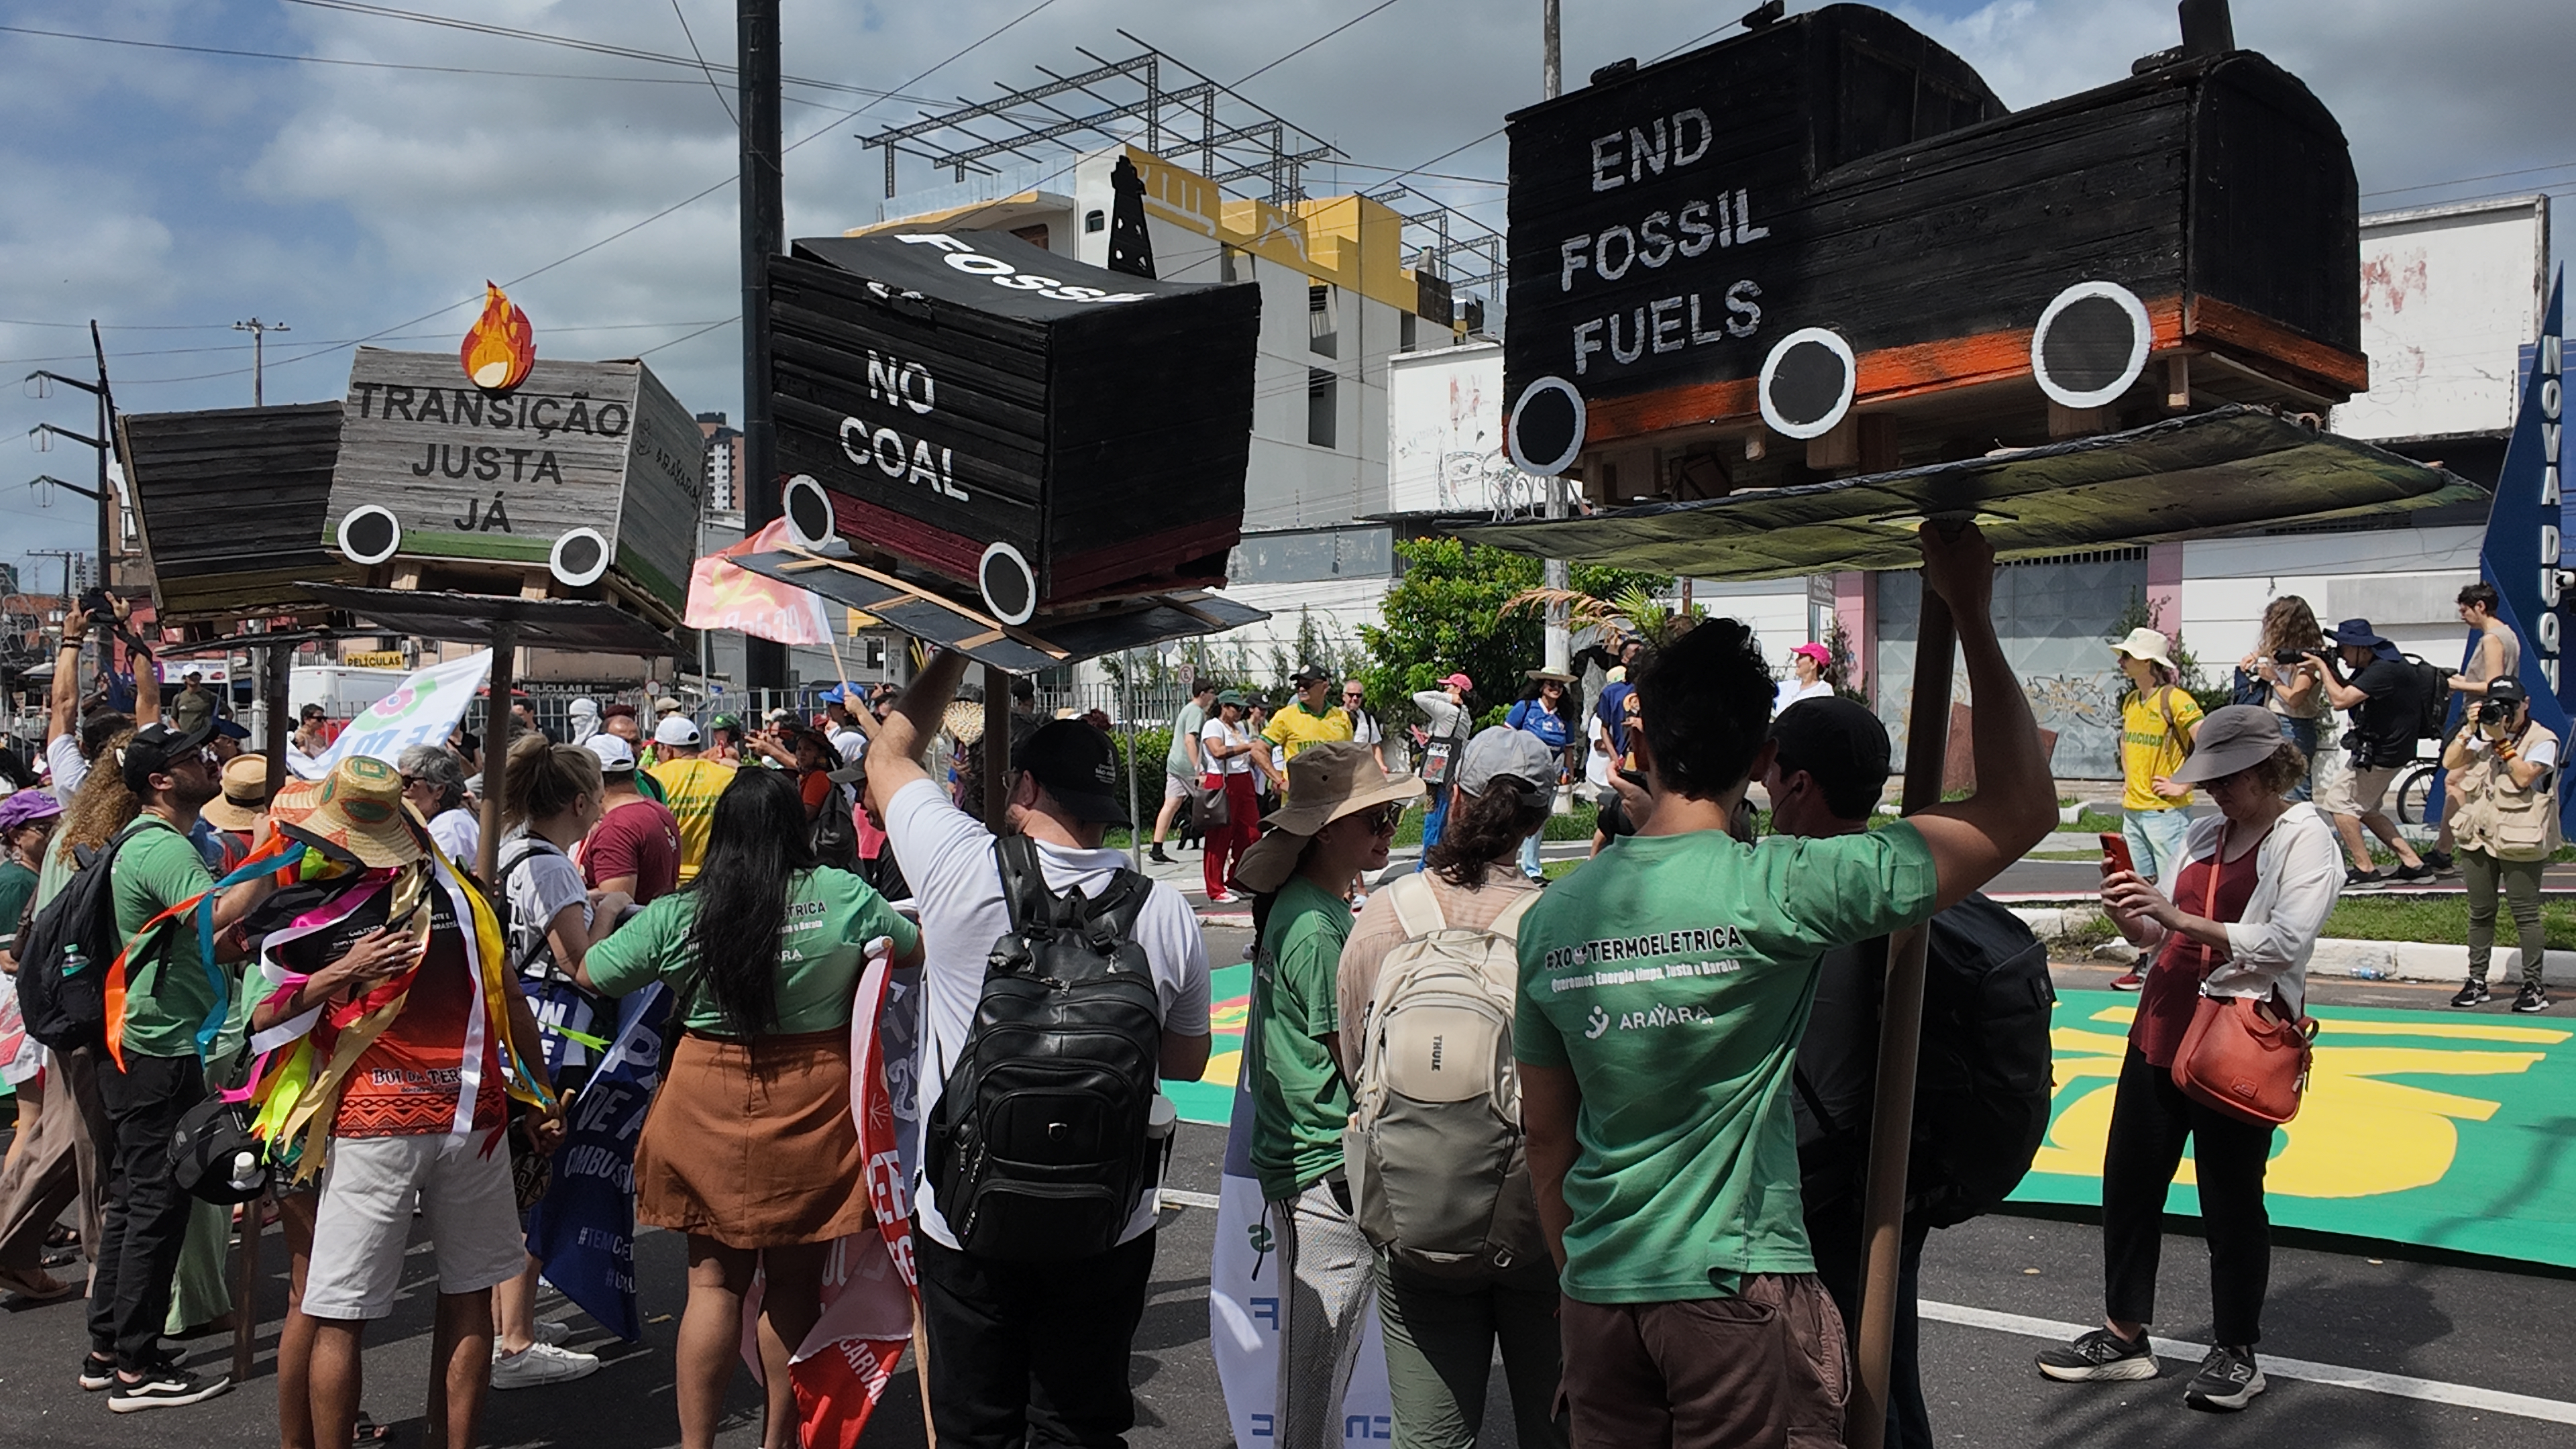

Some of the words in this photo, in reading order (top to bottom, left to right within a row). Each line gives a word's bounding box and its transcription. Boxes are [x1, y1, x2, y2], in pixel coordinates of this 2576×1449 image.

[1591, 107, 1713, 193] END
[1561, 188, 1770, 292] FOSSIL
[1572, 279, 1763, 376] FUELS
[867, 350, 935, 414] NO
[353, 382, 631, 439] TRANSIÇÃO
[2540, 335, 2562, 506] NOVA
[412, 443, 563, 485] JUSTA
[839, 416, 970, 502] COAL
[453, 490, 512, 534] JÁ
[347, 655, 400, 667] PELÍCULAS
[1587, 924, 1743, 964] TERMOELETRICA
[1701, 958, 1741, 975] Barata
[1619, 1003, 1711, 1031] ARAYARA
[1432, 1034, 1443, 1072] THULE
